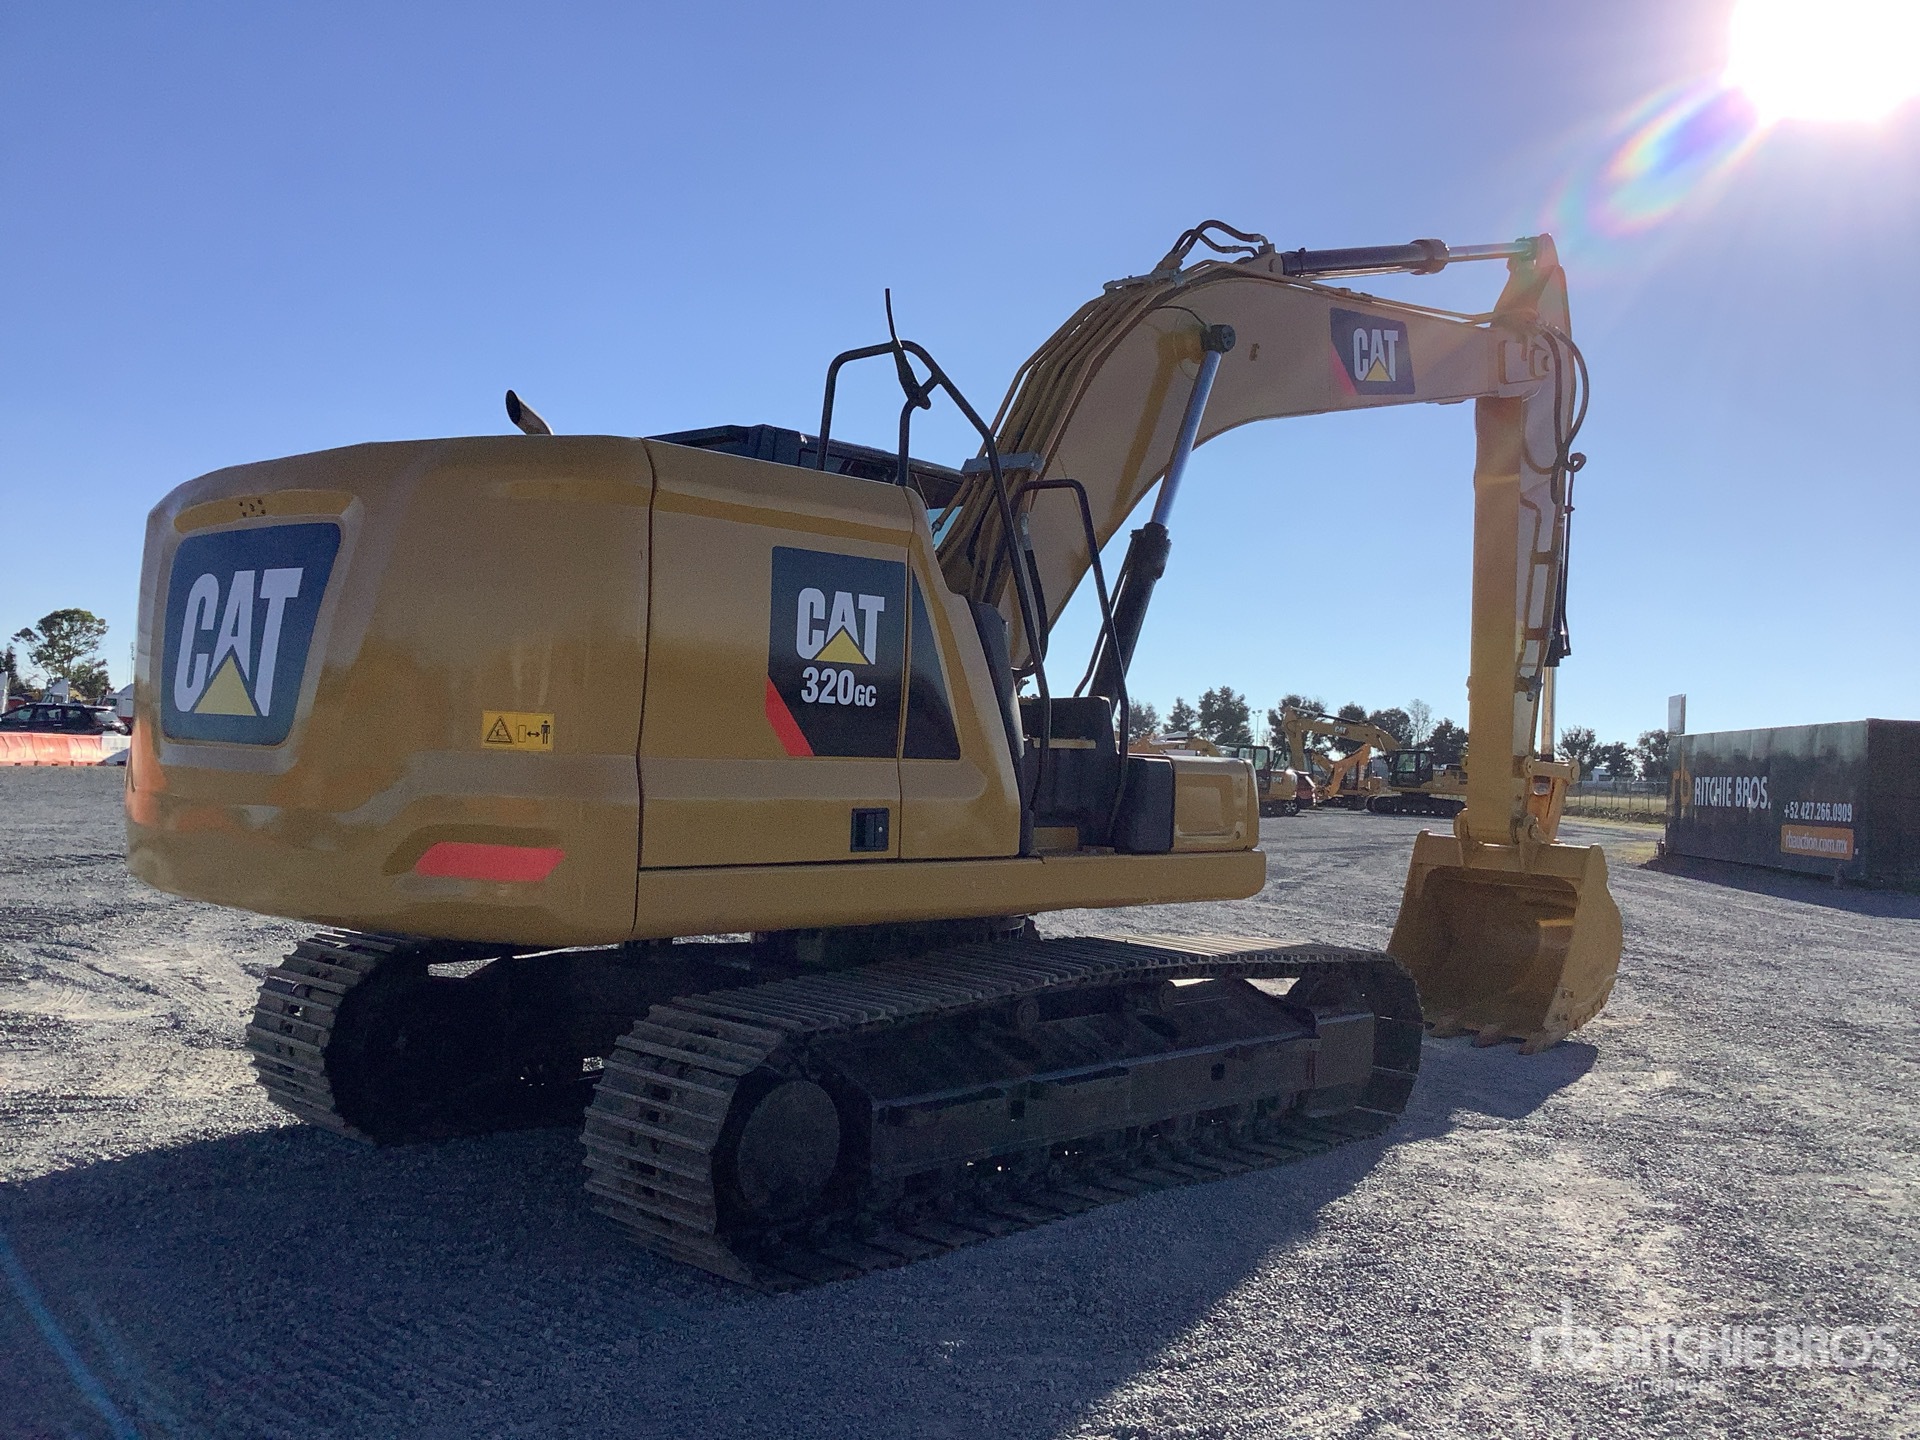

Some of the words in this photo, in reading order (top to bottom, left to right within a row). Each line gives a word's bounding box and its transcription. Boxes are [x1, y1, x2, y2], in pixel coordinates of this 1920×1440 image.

[1353, 328, 1399, 382] CAT
[174, 567, 304, 717] CAT
[796, 587, 885, 665] CAT
[1334, 726, 1347, 735] CAT
[1694, 776, 1732, 808] RITCHIE
[1735, 776, 1771, 810] BROS.
[1784, 801, 1799, 819] +52
[1800, 801, 1853, 823] 427.266.0909
